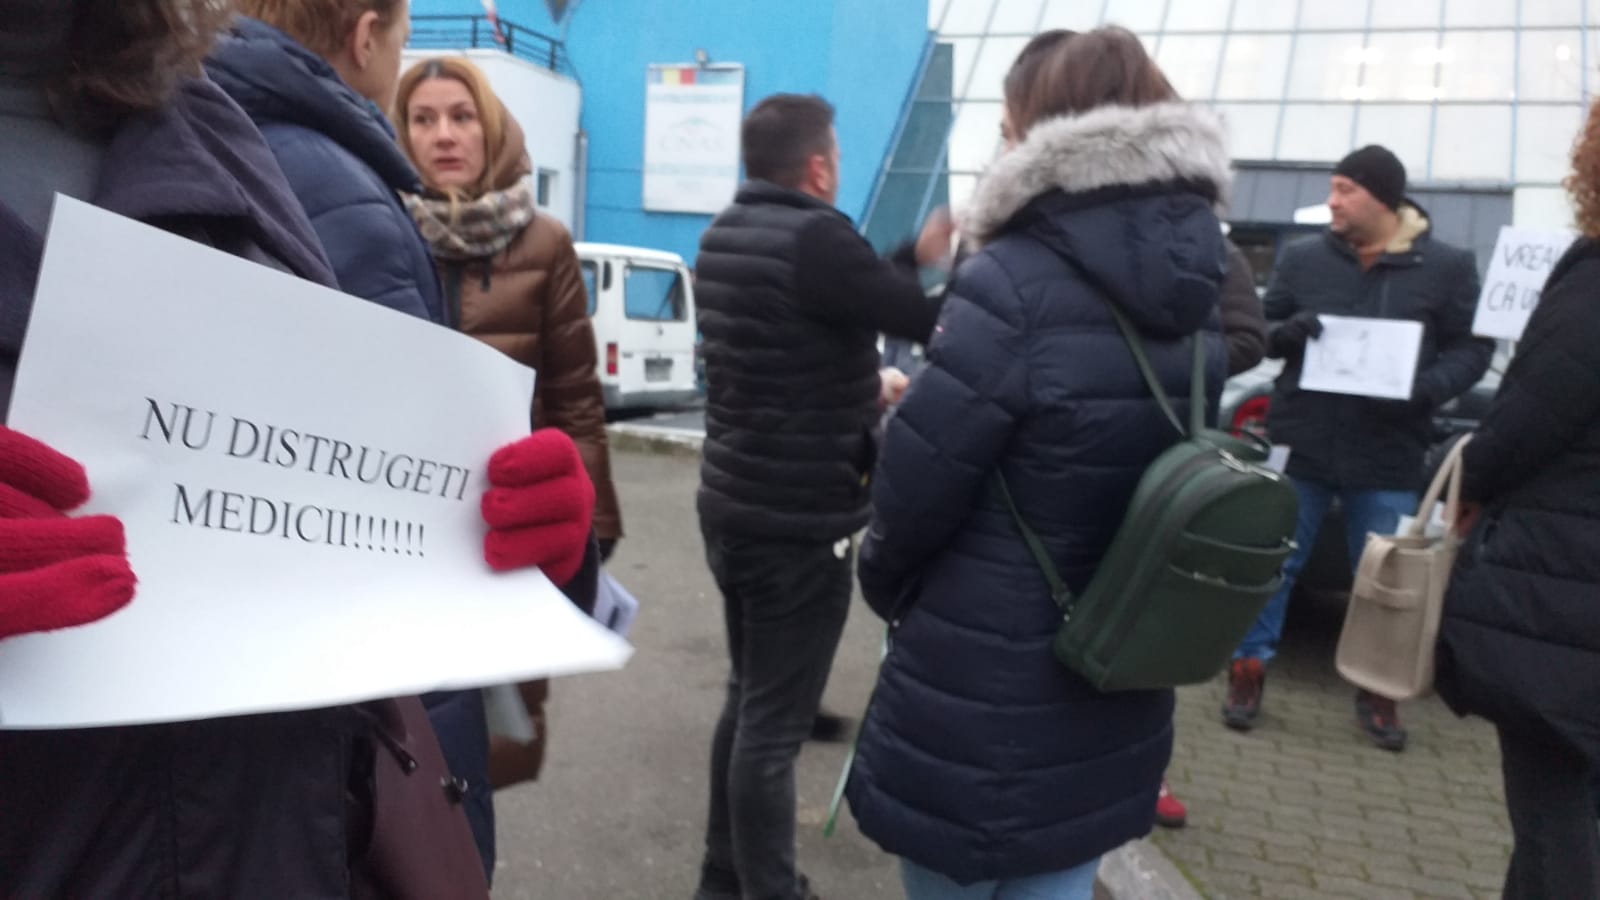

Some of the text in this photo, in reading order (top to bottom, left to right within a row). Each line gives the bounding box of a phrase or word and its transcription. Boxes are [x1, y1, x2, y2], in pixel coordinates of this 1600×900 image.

[1487, 281, 1517, 311] CA
[138, 397, 472, 501] NU DISTRUGETI
[170, 482, 425, 558] MEDICII!!!!!!
